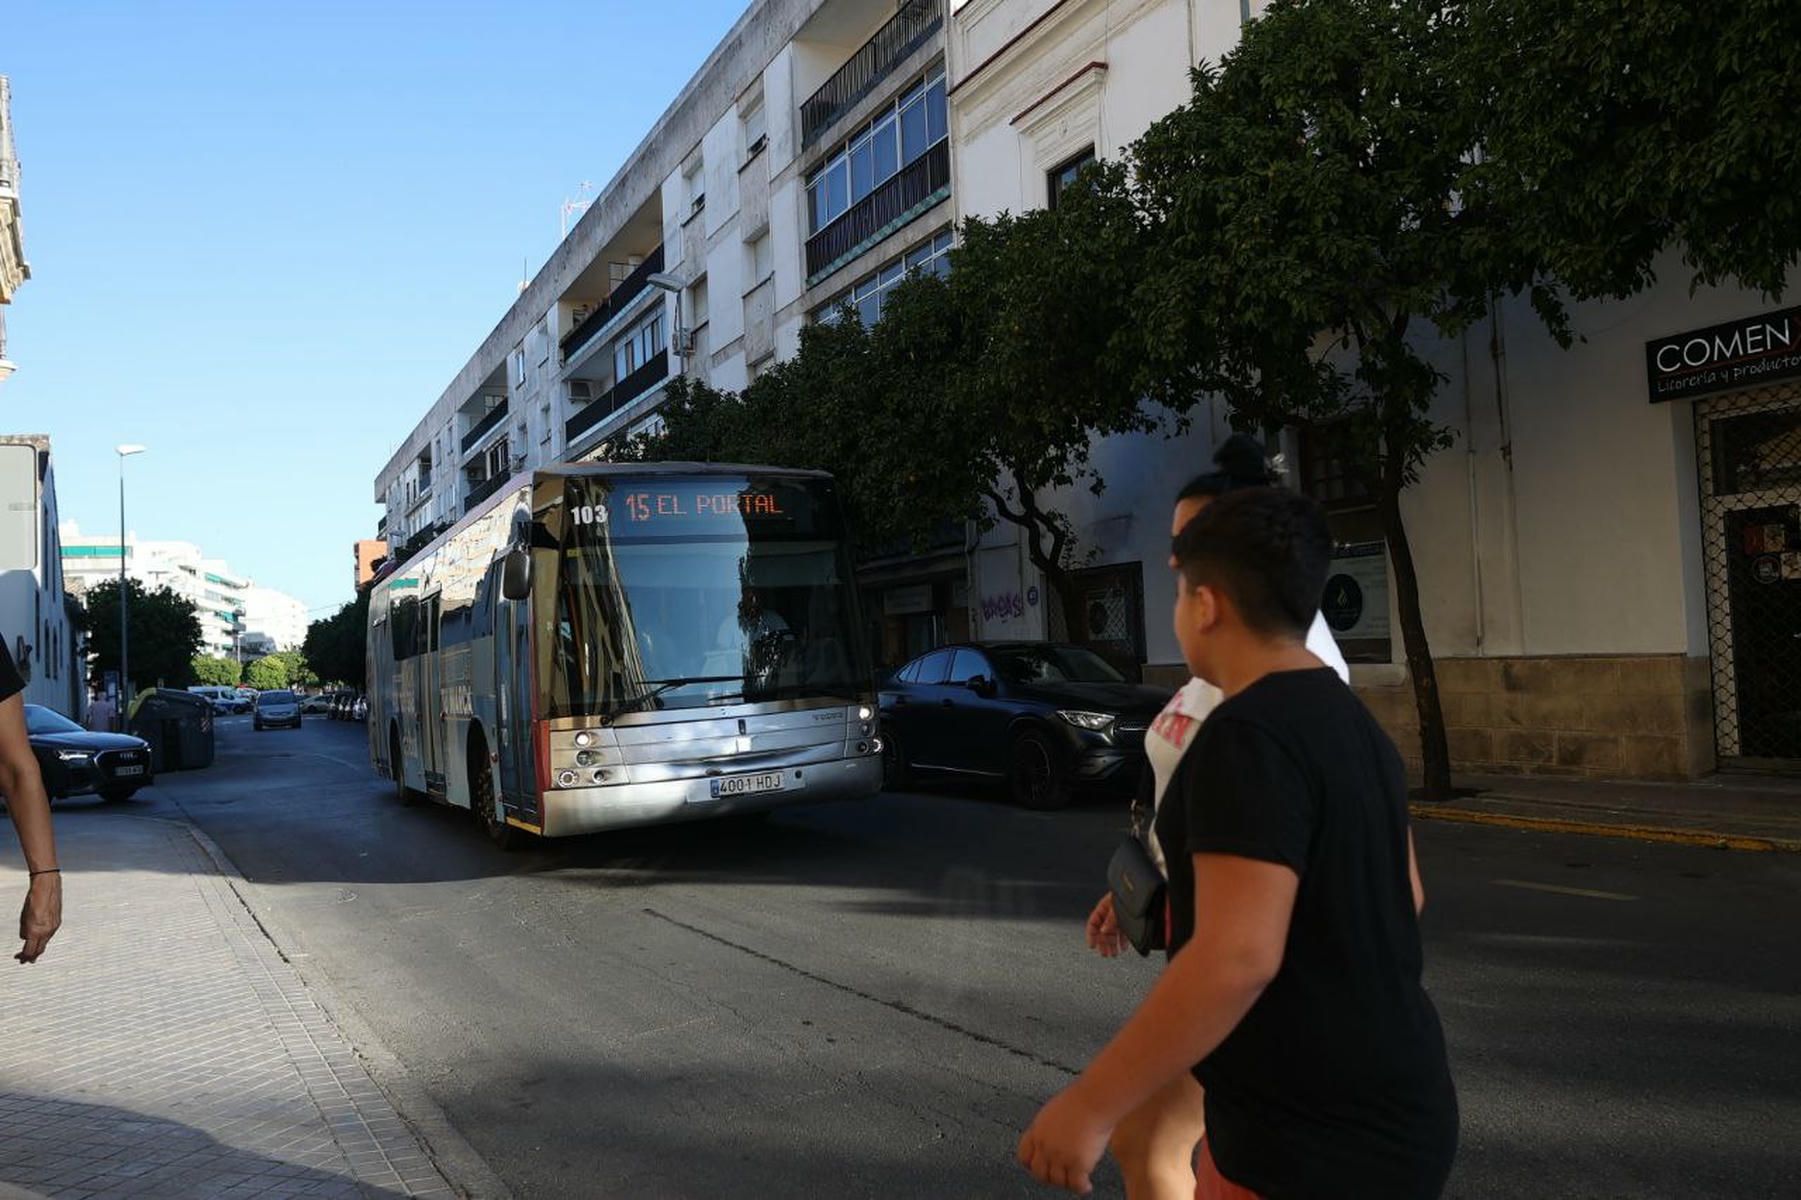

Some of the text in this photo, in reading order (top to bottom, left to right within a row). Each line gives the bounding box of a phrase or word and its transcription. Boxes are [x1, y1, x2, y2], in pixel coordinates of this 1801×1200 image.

[1721, 370, 1729, 382] y
[1733, 355, 1801, 381] producto
[571, 505, 608, 525] 103
[626, 494, 783, 521] 15 EL PORTAL
[720, 773, 781, 792] 4001 HDJ
